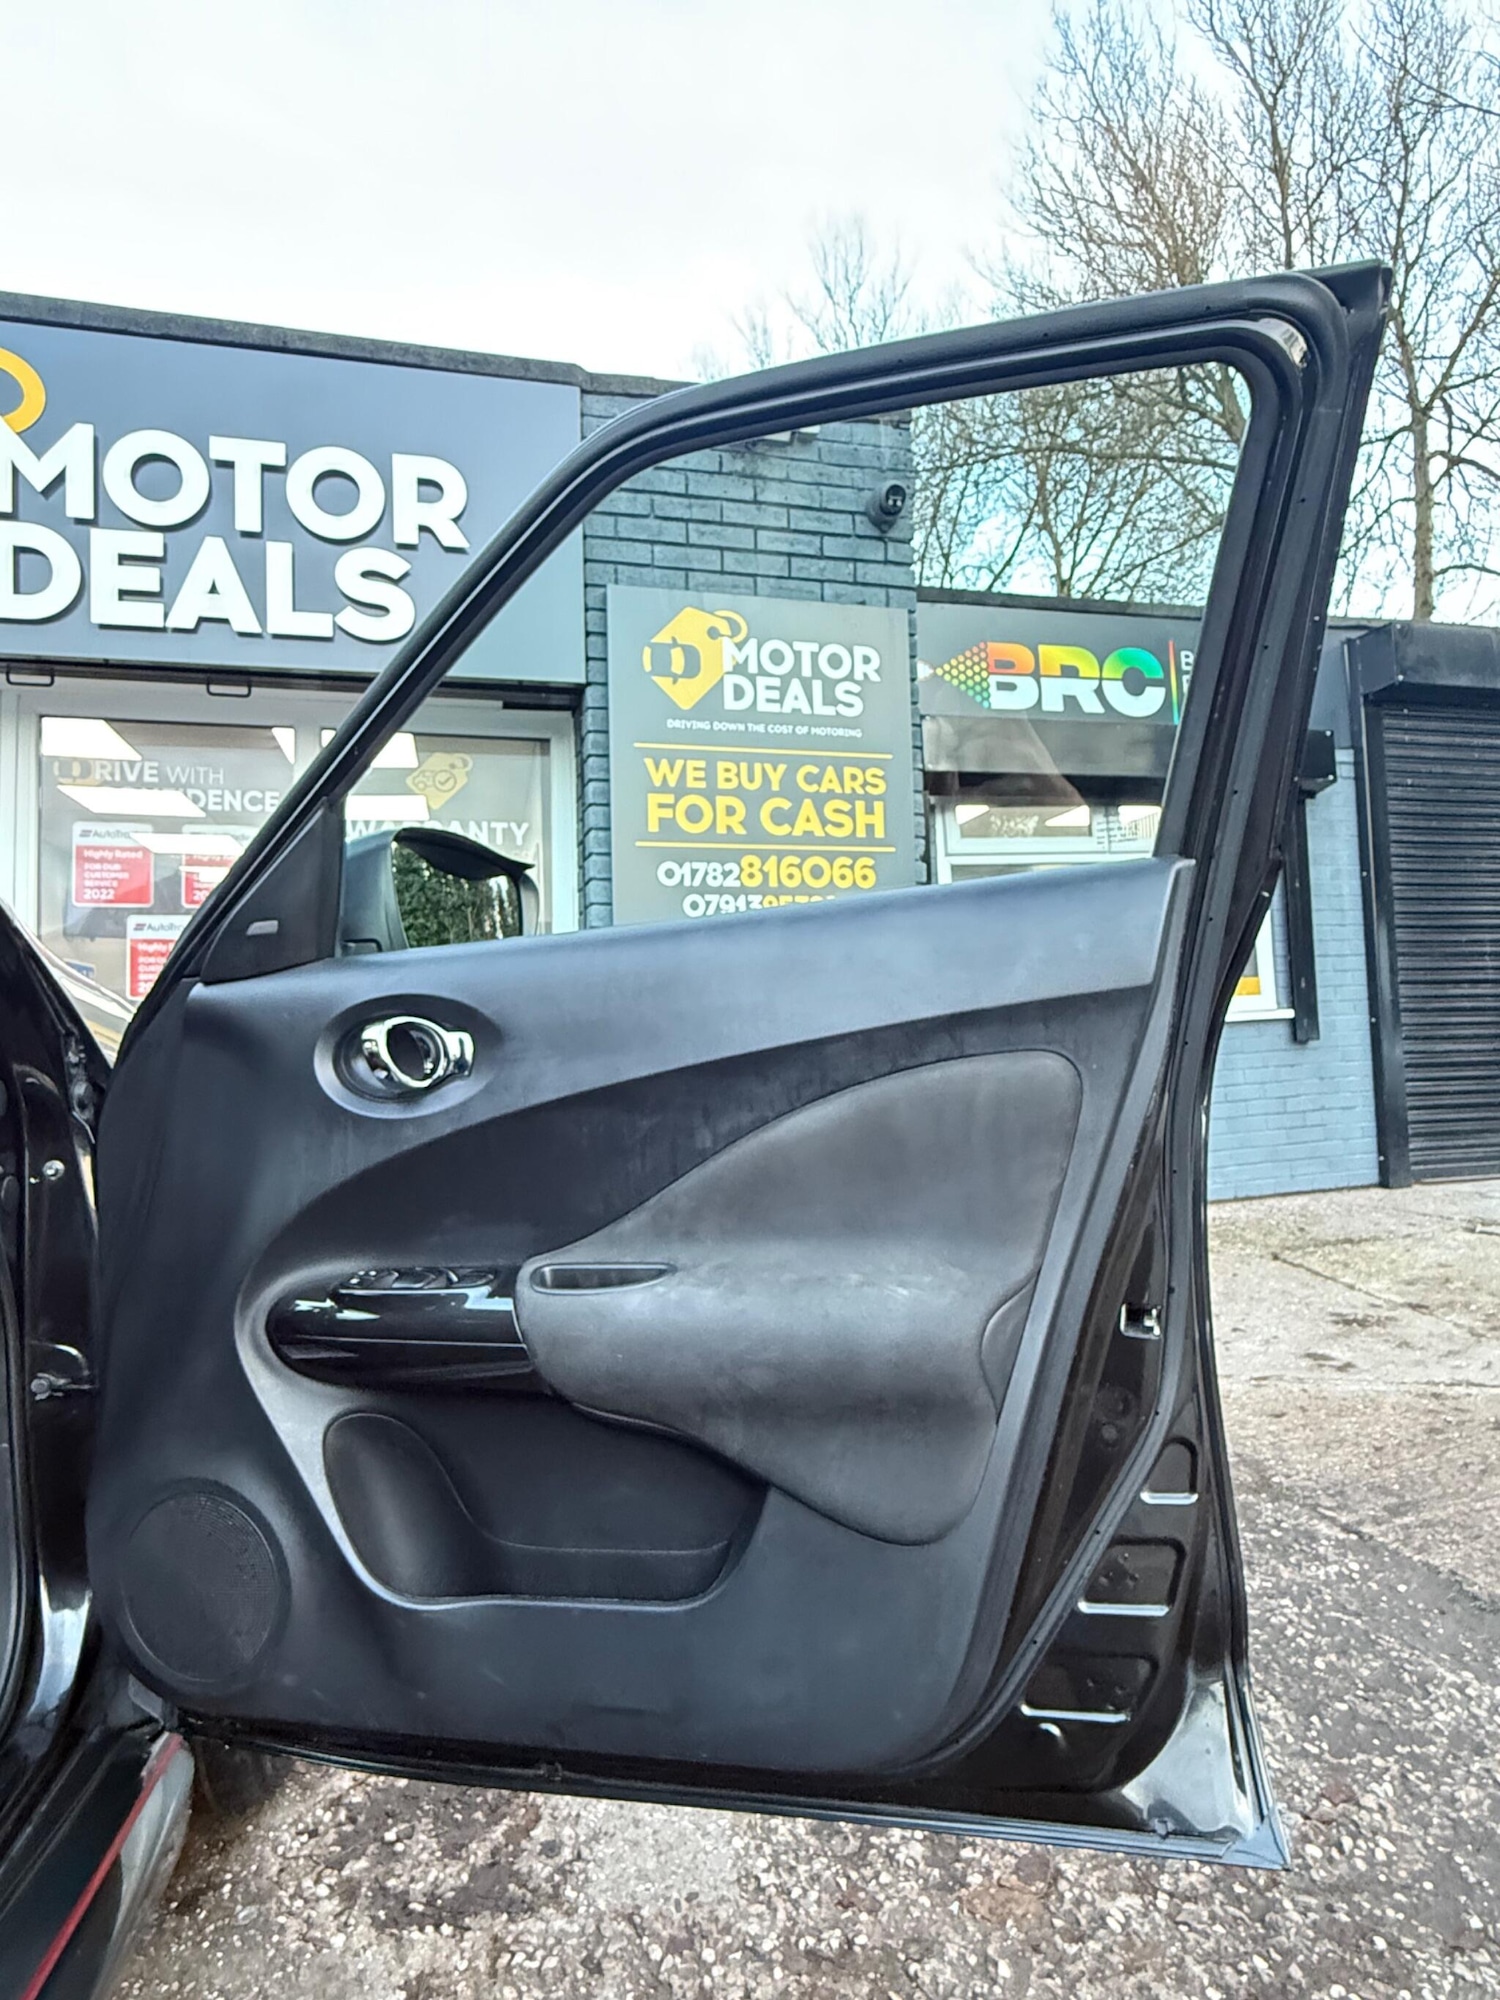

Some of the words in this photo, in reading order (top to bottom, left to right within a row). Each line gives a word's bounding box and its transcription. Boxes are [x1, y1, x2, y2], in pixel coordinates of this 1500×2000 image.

[0, 415, 470, 551] MOTOR
[0, 522, 416, 643] DEALS
[722, 637, 881, 682] MOTOR
[987, 641, 1167, 718] BRC
[723, 674, 864, 717] DEALS
[666, 719, 711, 730] DRIVING
[713, 721, 745, 732] DOWN
[747, 723, 765, 733] THE
[767, 724, 793, 734] COST
[795, 725, 809, 735] OF
[811, 726, 863, 738] MOTORING
[166, 766, 224, 785] WITH
[644, 757, 707, 788] WE
[716, 761, 787, 791] BUY
[796, 764, 887, 795] CARS
[647, 792, 747, 835] FOR
[759, 797, 886, 839] CASH
[657, 854, 877, 889] 01782816066
[83, 888, 115, 900] 2022
